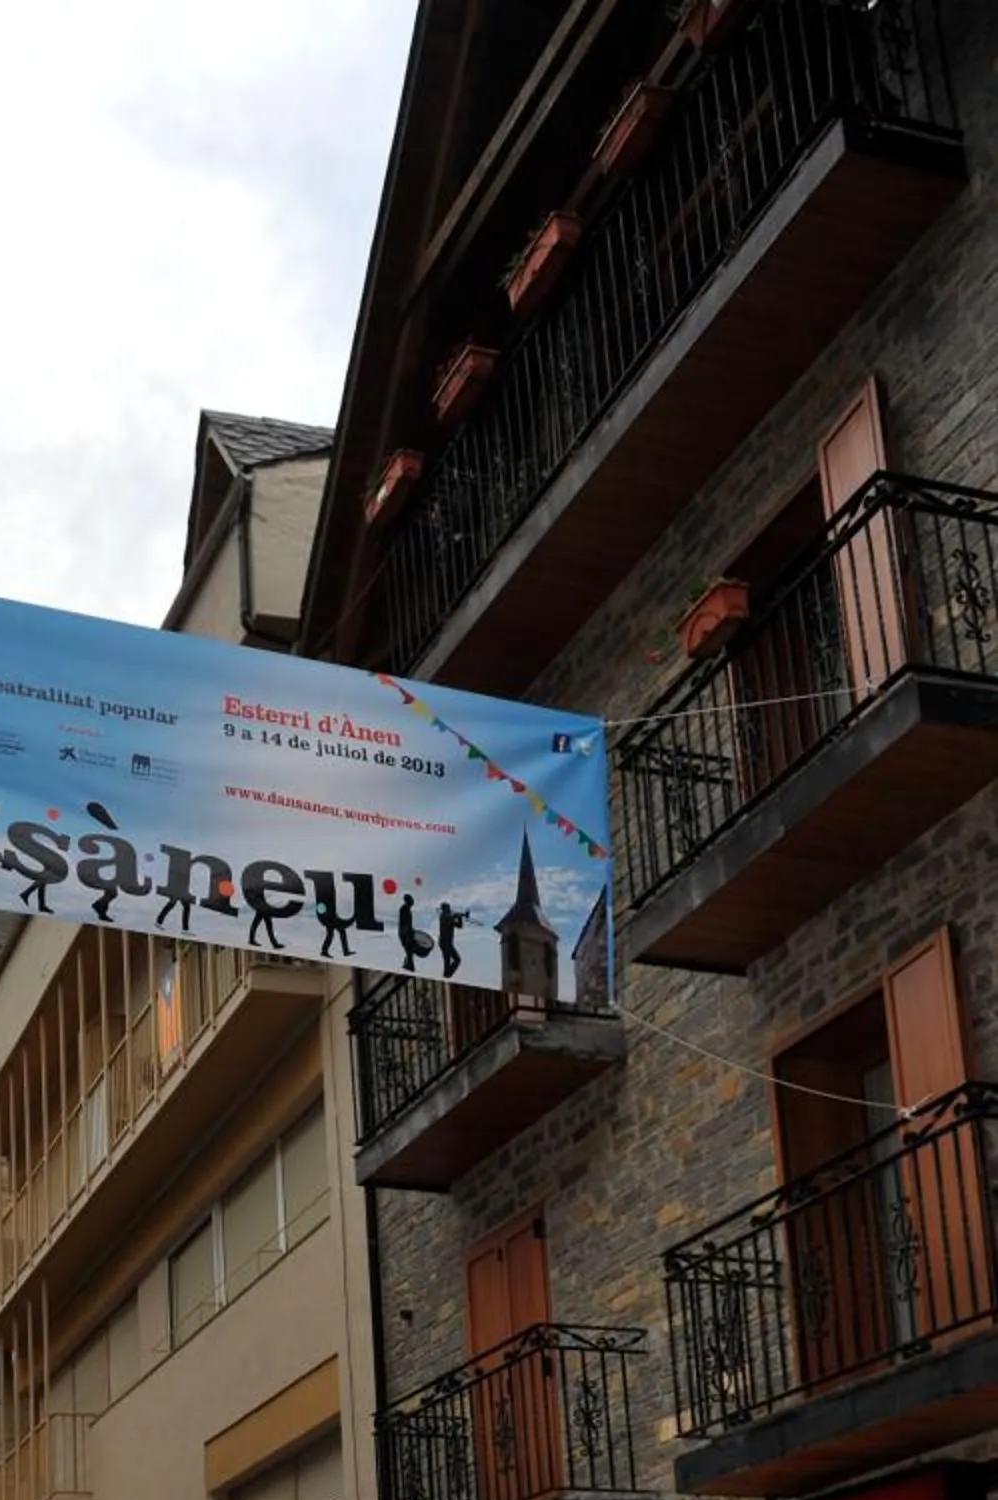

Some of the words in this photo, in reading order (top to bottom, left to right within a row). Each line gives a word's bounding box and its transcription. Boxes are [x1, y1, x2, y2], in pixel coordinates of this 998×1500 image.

[99, 700, 178, 725] popular
[223, 695, 311, 730] Esterri
[223, 723, 235, 737] 9
[241, 729, 253, 740] a
[260, 731, 282, 746] 14
[288, 735, 310, 751] de
[315, 739, 368, 762] juliol
[373, 751, 396, 767] de
[401, 755, 446, 778] 2013
[224, 785, 456, 834] www.dansaneu.wordpress.com
